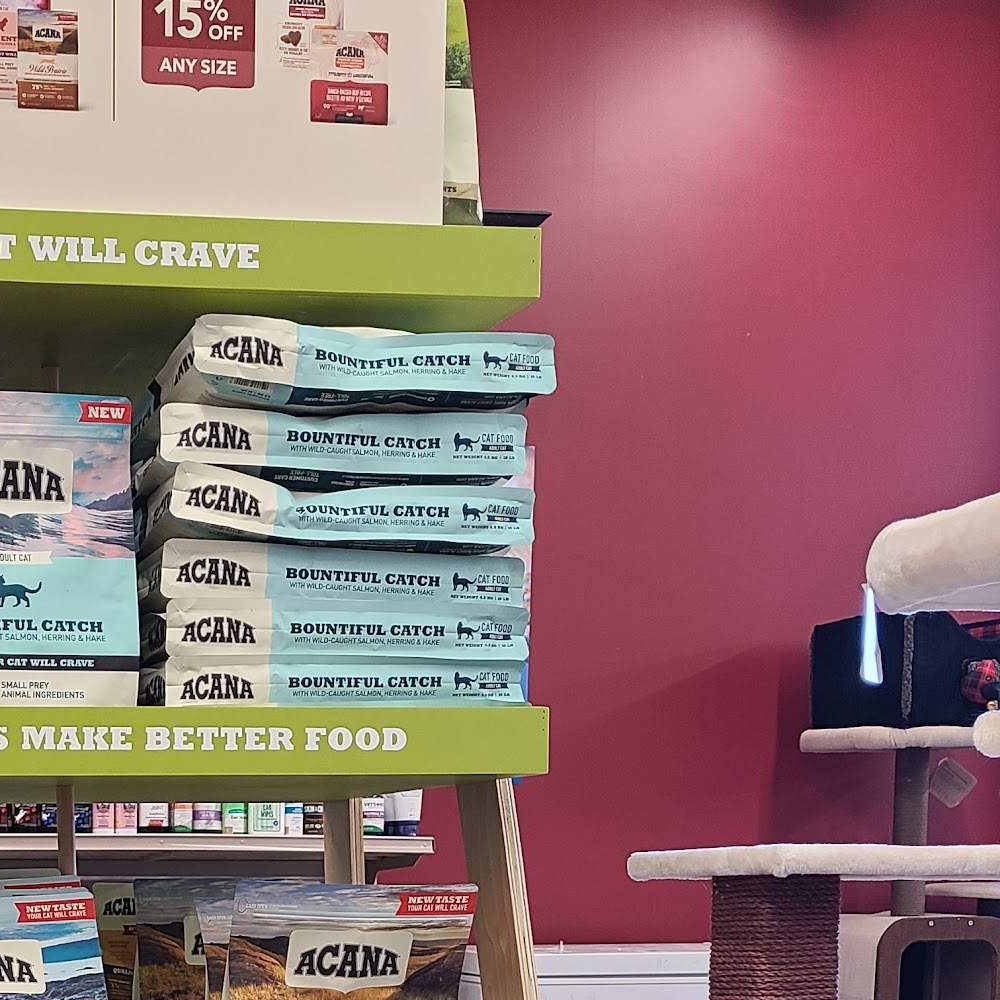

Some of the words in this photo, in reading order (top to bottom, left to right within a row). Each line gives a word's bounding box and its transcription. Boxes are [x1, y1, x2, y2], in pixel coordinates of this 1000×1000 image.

[154, 0, 228, 38] 15%
[34, 29, 61, 39] ACANA
[208, 25, 243, 41] OFF
[336, 47, 364, 57] ACANA
[159, 57, 198, 73] ANY
[201, 59, 237, 76] SIZE
[28, 235, 126, 264] WILL
[134, 240, 259, 269] CRAVE
[210, 336, 284, 367] ACANA
[315, 349, 408, 369] BOUNTIFUL
[412, 353, 471, 368] CATCH
[87, 406, 125, 419] NEW
[177, 421, 252, 450] ACANA
[287, 430, 380, 448] BOUNTIFUL
[384, 434, 441, 449] CATCH
[19, 553, 32, 562] CAT
[41, 620, 103, 633] CATCH
[5, 633, 40, 642] SALMON,
[42, 634, 76, 642] HERRING
[85, 634, 106, 642] HAKE
[7, 658, 28, 667] CAT
[31, 658, 57, 667] WILL
[59, 659, 95, 668] CRAVE
[1, 682, 28, 690] SMALL
[29, 682, 49, 690] PREY
[179, 673, 254, 700] ACANA
[288, 677, 384, 689] BOUNTIFUL
[387, 676, 442, 689] CATCH
[1, 690, 31, 698] ANIMAL
[33, 691, 84, 699] INGREDIENTS
[21, 726, 133, 751] MAKE
[144, 726, 295, 752] BETTER
[304, 727, 408, 752] FOOD
[25, 904, 49, 913] NEW
[51, 902, 86, 912] TASTE
[293, 944, 400, 977] ACANA
